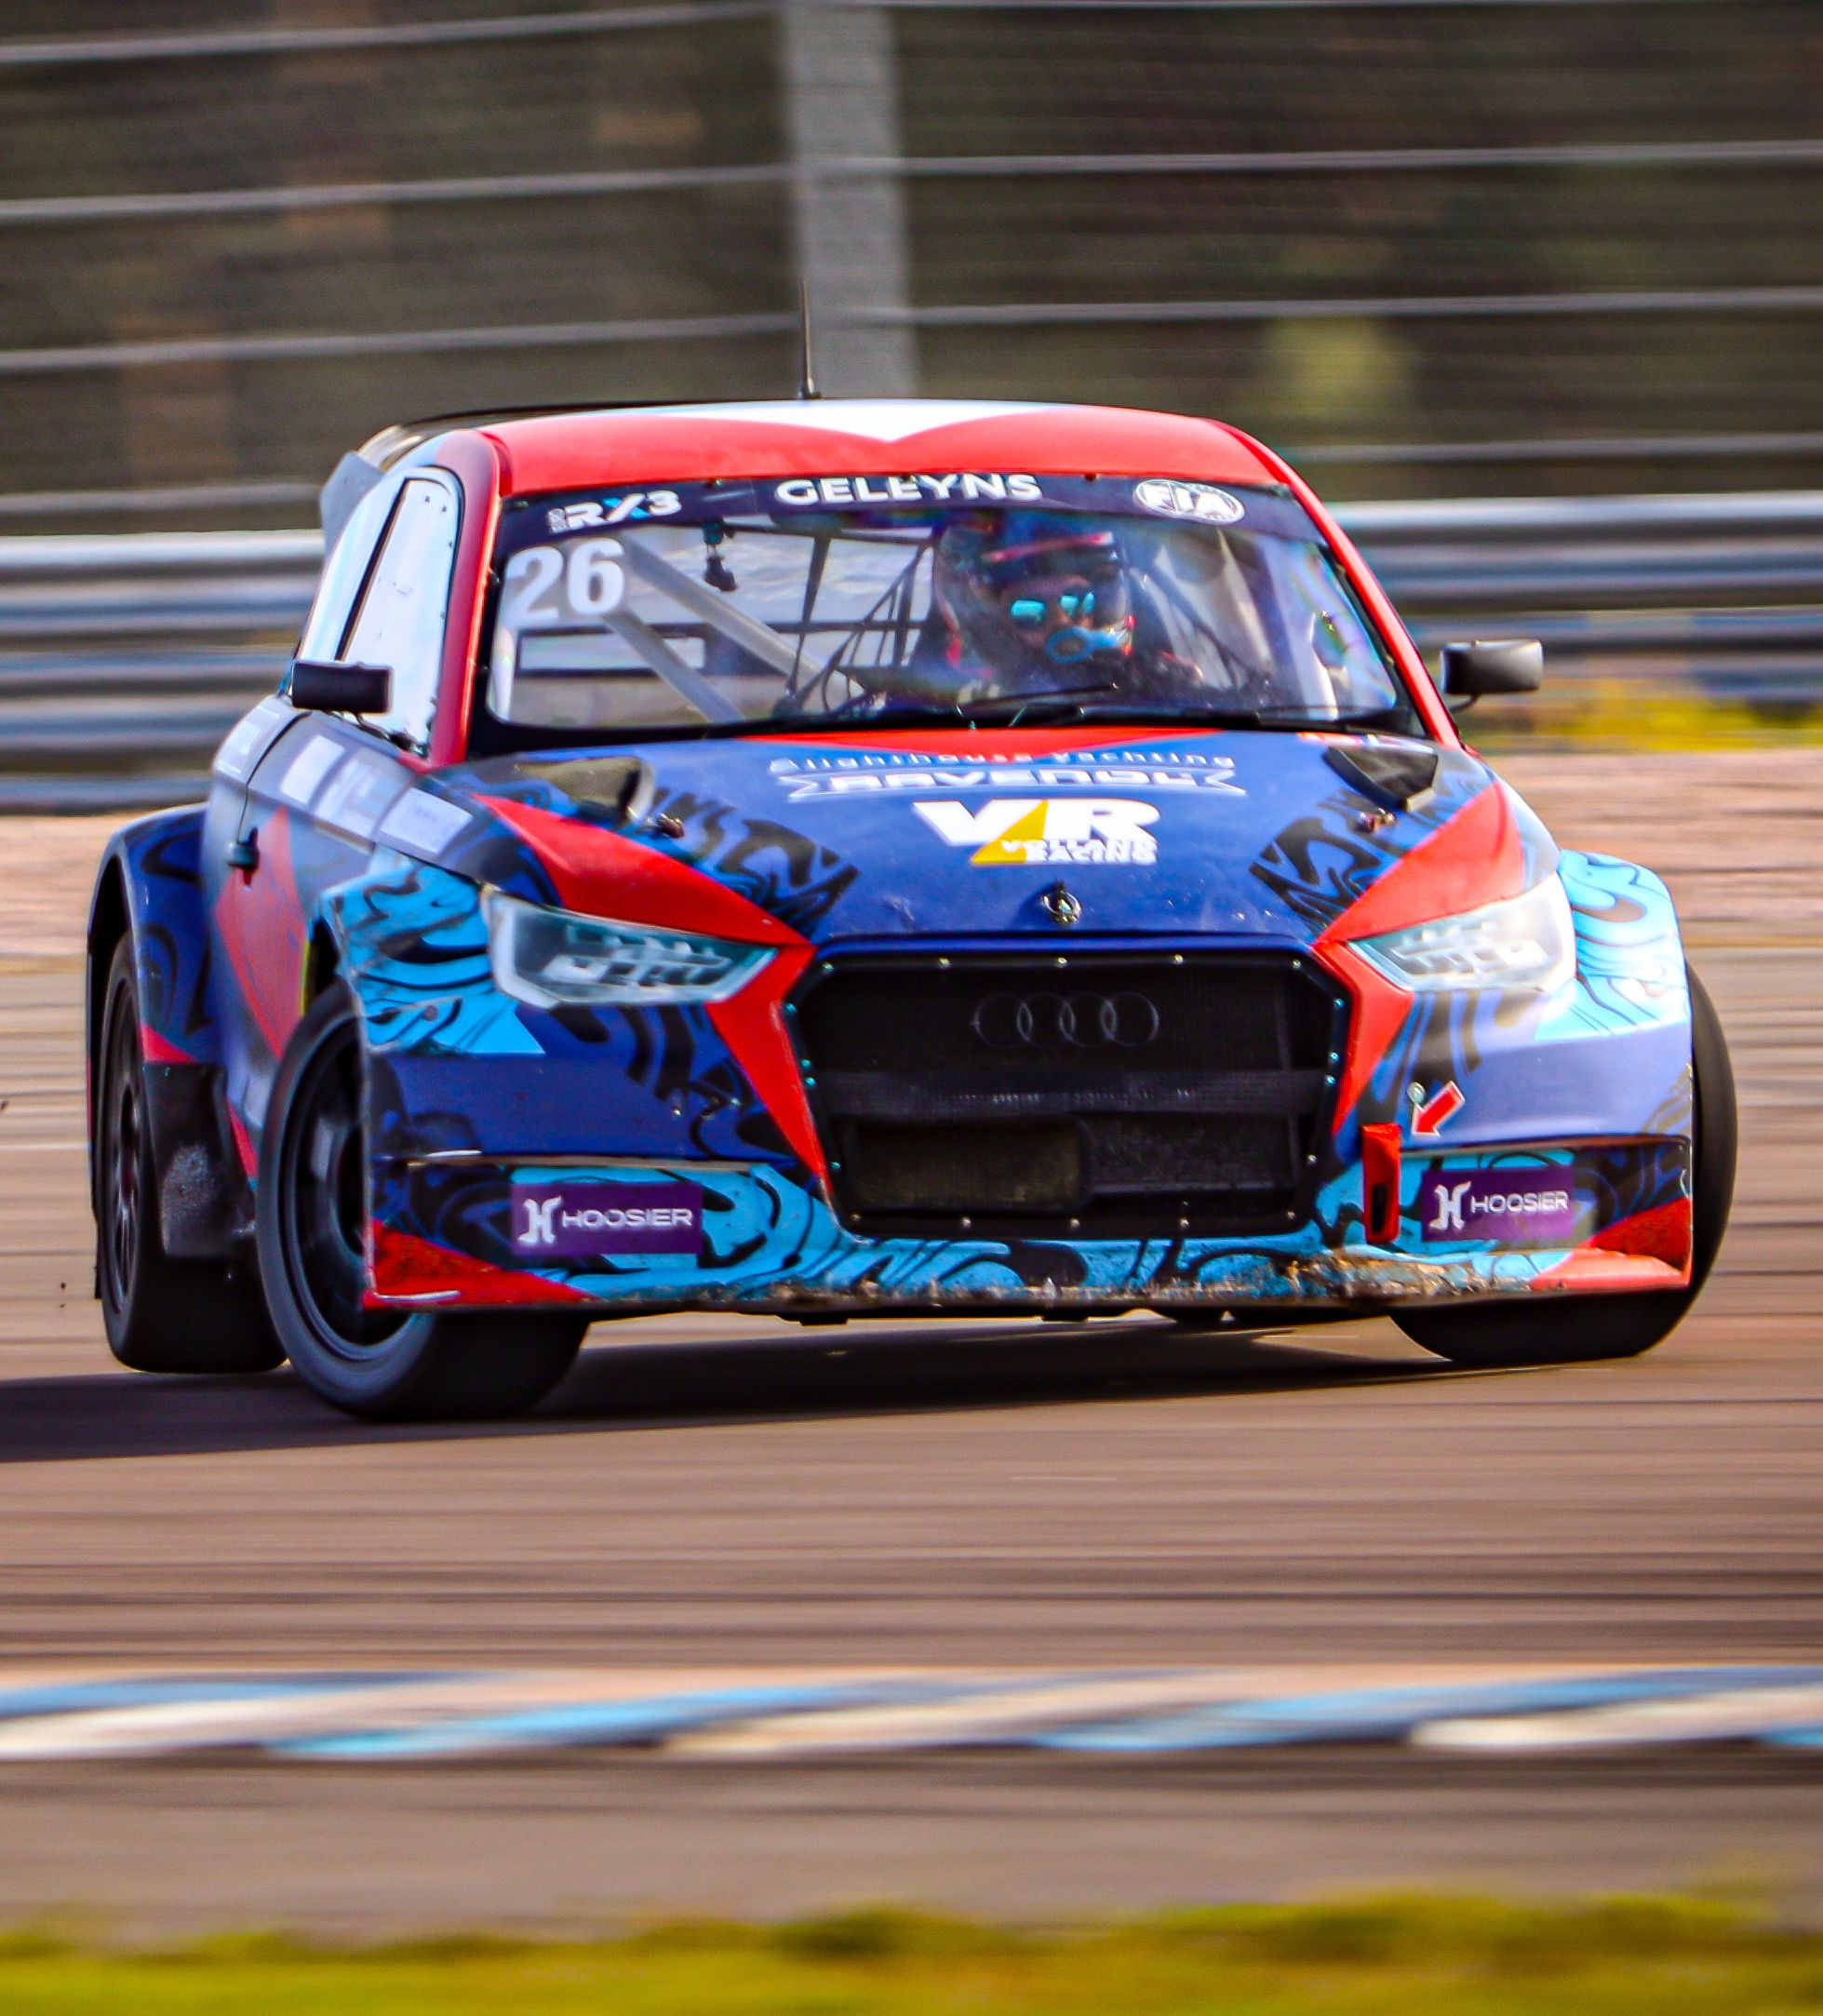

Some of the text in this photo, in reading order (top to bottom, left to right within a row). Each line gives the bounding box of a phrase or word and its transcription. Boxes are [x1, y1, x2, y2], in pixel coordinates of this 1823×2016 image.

[774, 474, 1043, 504] GELEYNS
[1140, 482, 1239, 519] FIA
[505, 538, 625, 622] 26
[912, 798, 1160, 847] VR
[1471, 1190, 1569, 1213] HOOSIER
[561, 1208, 693, 1229] HOOSIER
